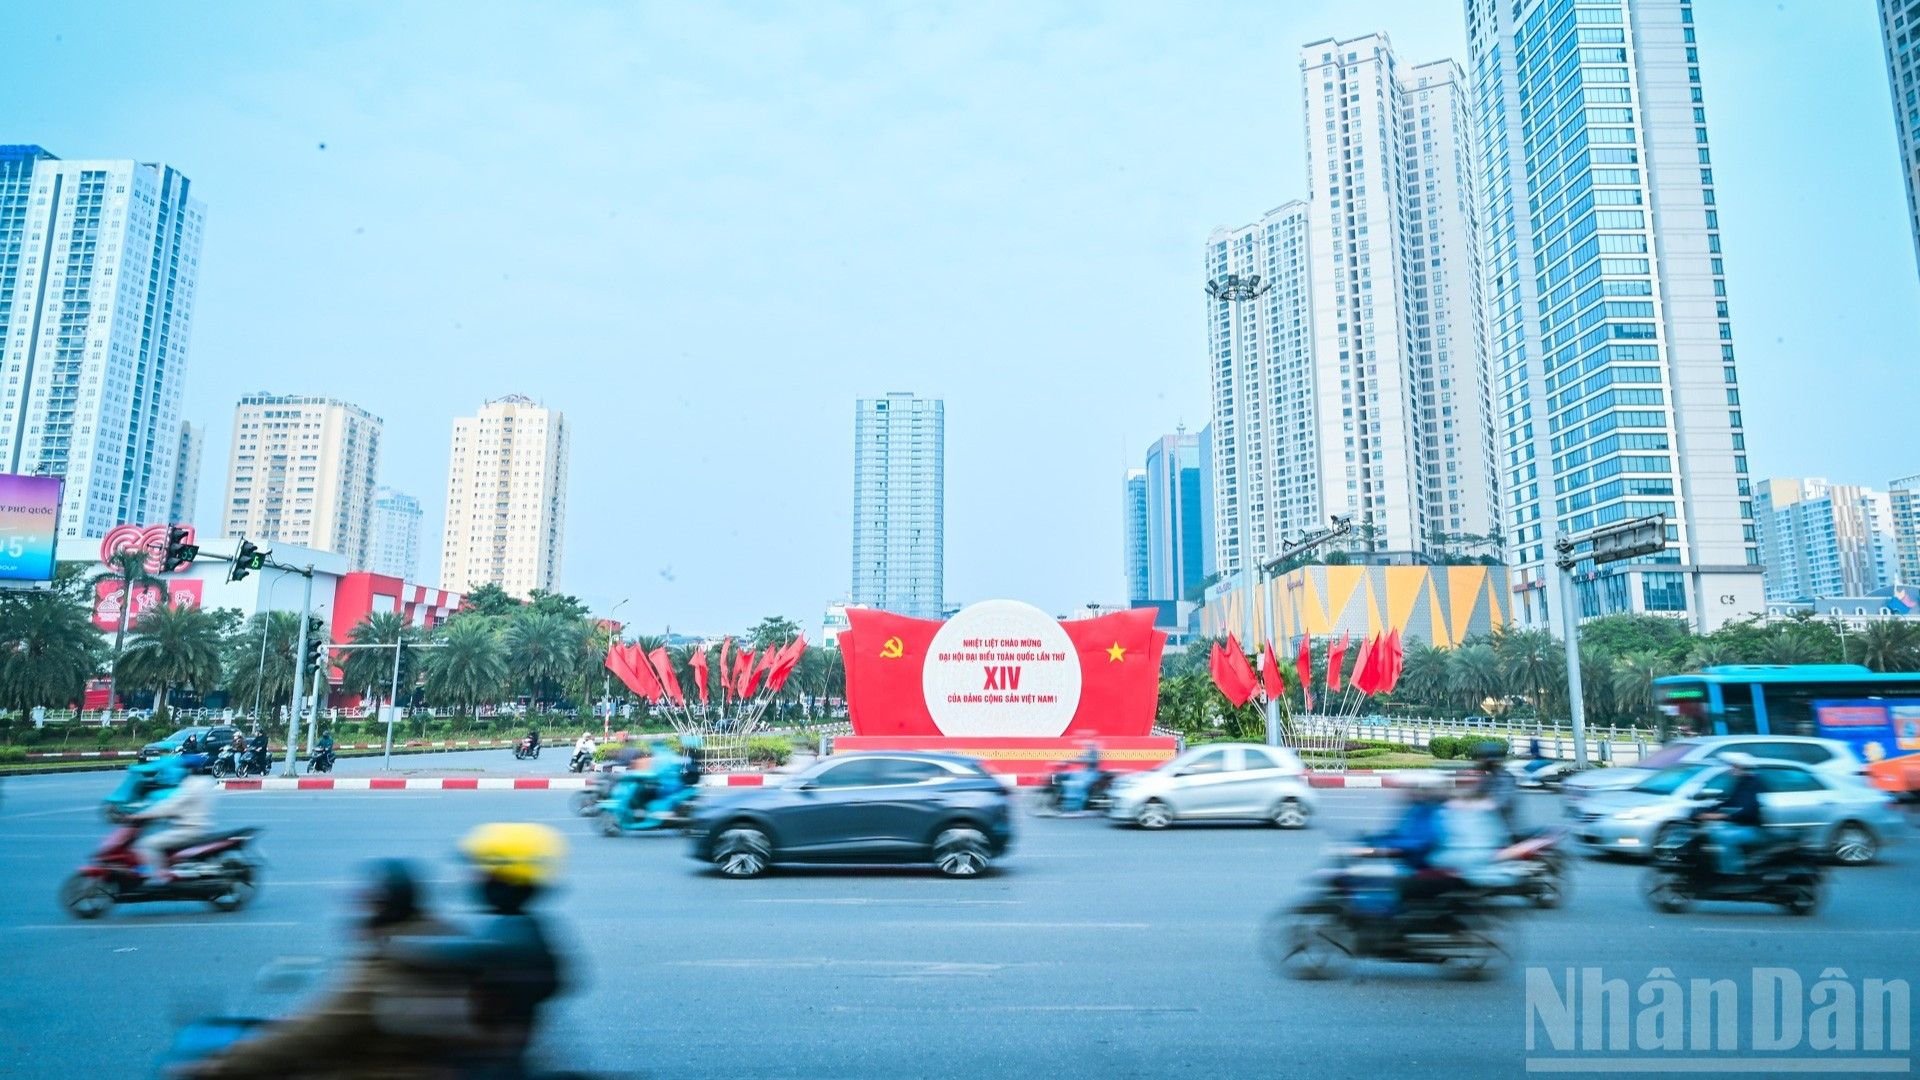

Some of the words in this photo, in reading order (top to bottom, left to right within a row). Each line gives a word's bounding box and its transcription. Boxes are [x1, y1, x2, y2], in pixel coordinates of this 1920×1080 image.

[28, 507, 53, 515] QUỐC
[1720, 595, 1735, 605] C5
[963, 638, 983, 648] NHIỆT
[984, 638, 998, 649] LIỆT
[1000, 638, 1018, 647] CHÀO
[1020, 637, 1041, 647] MỪNG
[939, 653, 950, 662] ĐẠI
[953, 652, 963, 662] HỘI
[966, 653, 977, 662] ĐẠI
[979, 650, 994, 661] BIỂU
[997, 651, 1014, 661] TOÀN
[1017, 650, 1034, 661] QUỐC
[1037, 651, 1050, 661] LẦN
[1052, 651, 1065, 661] THỨ
[983, 666, 1021, 690] XIV
[947, 693, 961, 702] CỦA
[963, 693, 982, 702] ĐẢNG
[984, 694, 1003, 704] CỘNG
[1005, 693, 1019, 702] SẢN
[1021, 693, 1035, 704] VIỆT
